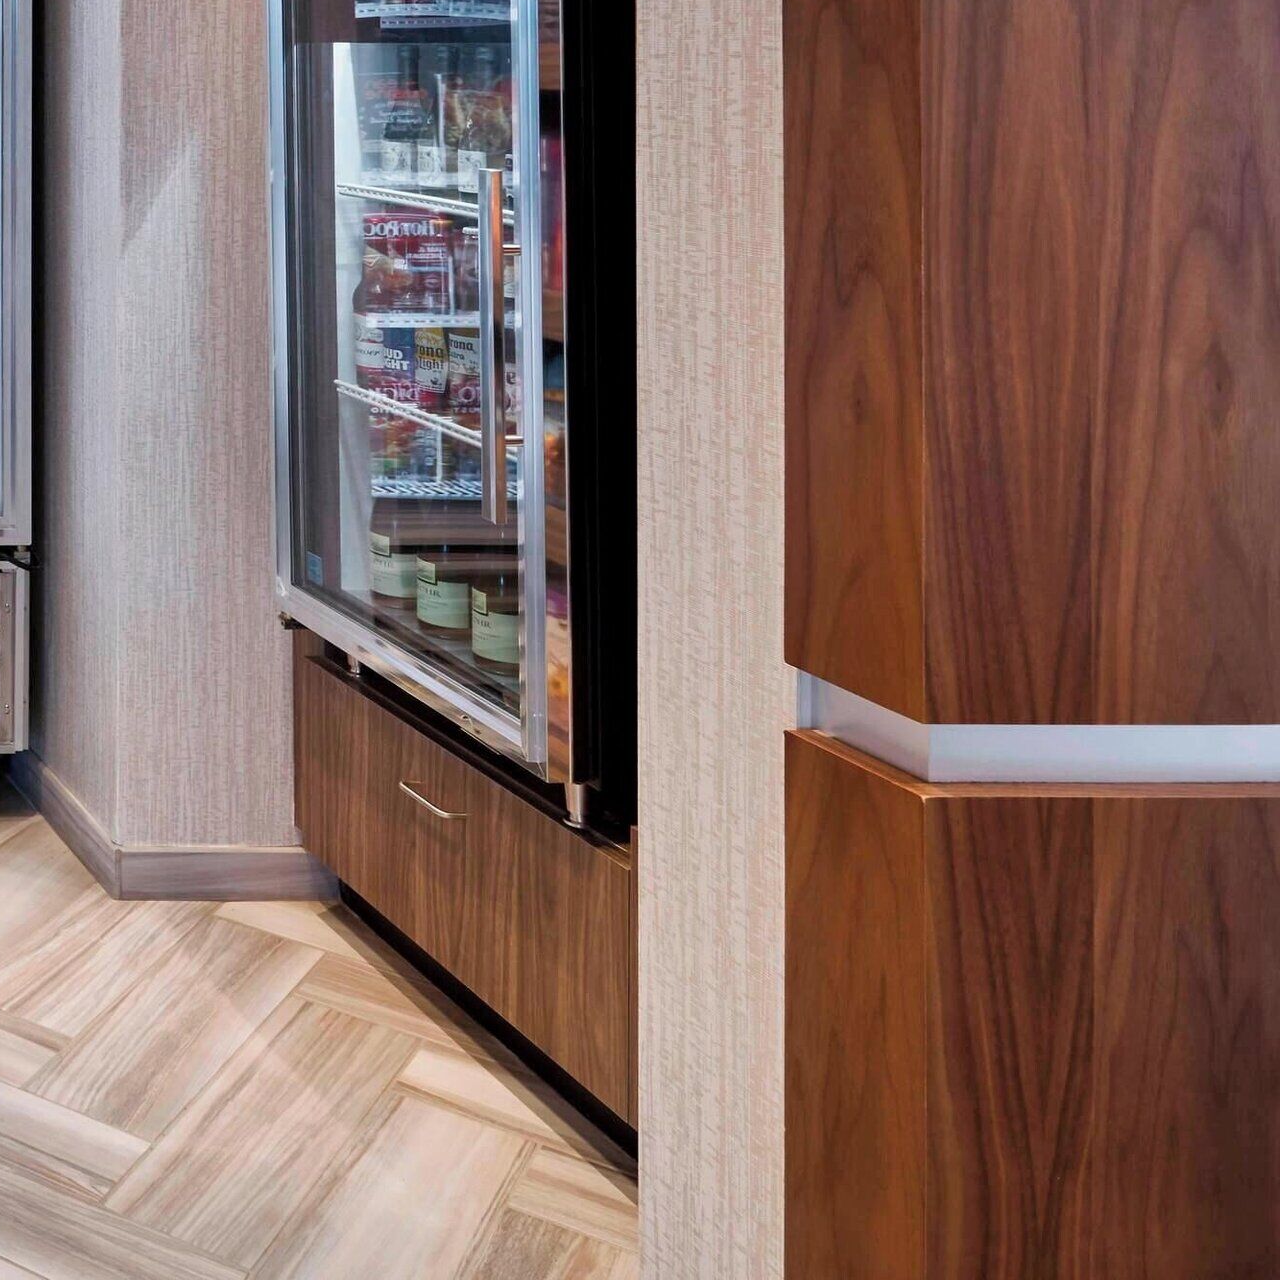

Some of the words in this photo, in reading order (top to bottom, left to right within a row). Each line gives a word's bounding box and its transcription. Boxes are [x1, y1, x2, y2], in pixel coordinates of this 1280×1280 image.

[416, 344, 444, 359] rona
[449, 338, 476, 352] rona
[383, 347, 403, 359] UD
[384, 359, 410, 371] GHT
